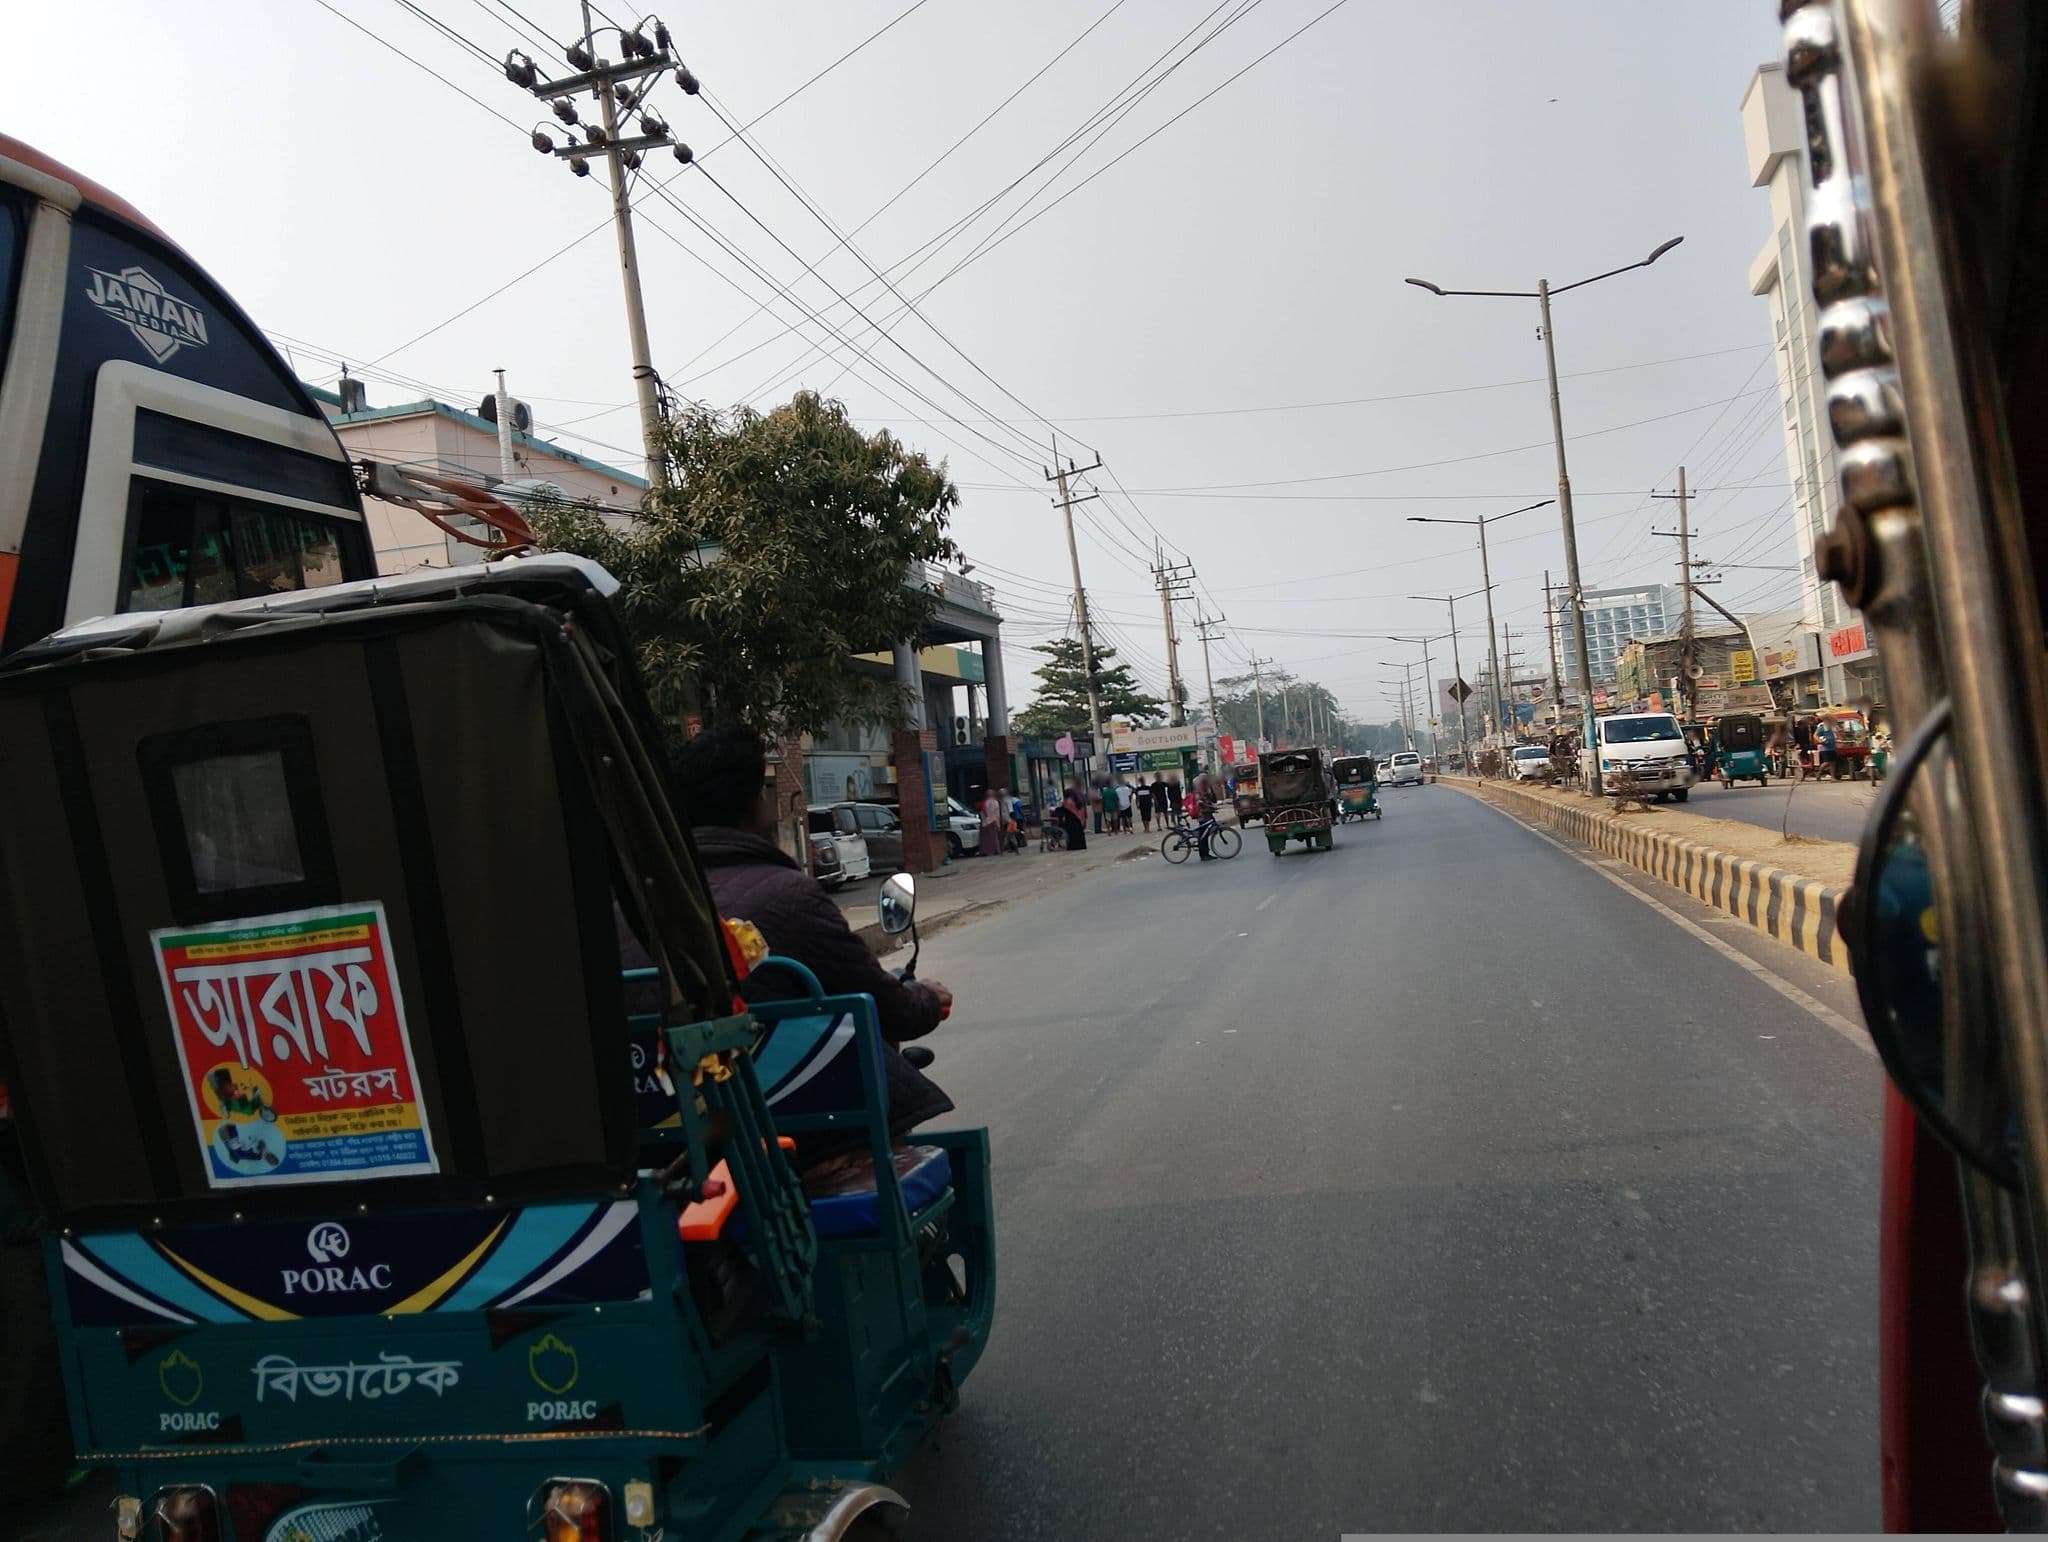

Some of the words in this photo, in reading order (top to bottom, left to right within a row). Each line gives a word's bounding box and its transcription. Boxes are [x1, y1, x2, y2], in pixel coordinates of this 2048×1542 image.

[85, 273, 208, 344] JAMAN
[124, 311, 180, 337] MEDIA
[174, 947, 379, 1069] আরাফ
[303, 1065, 403, 1102] মটরস্
[280, 1264, 392, 1294] PORAC
[251, 1351, 462, 1402] বিভাটেক
[159, 1412, 220, 1431] PORAC
[526, 1400, 597, 1421] PORAC
